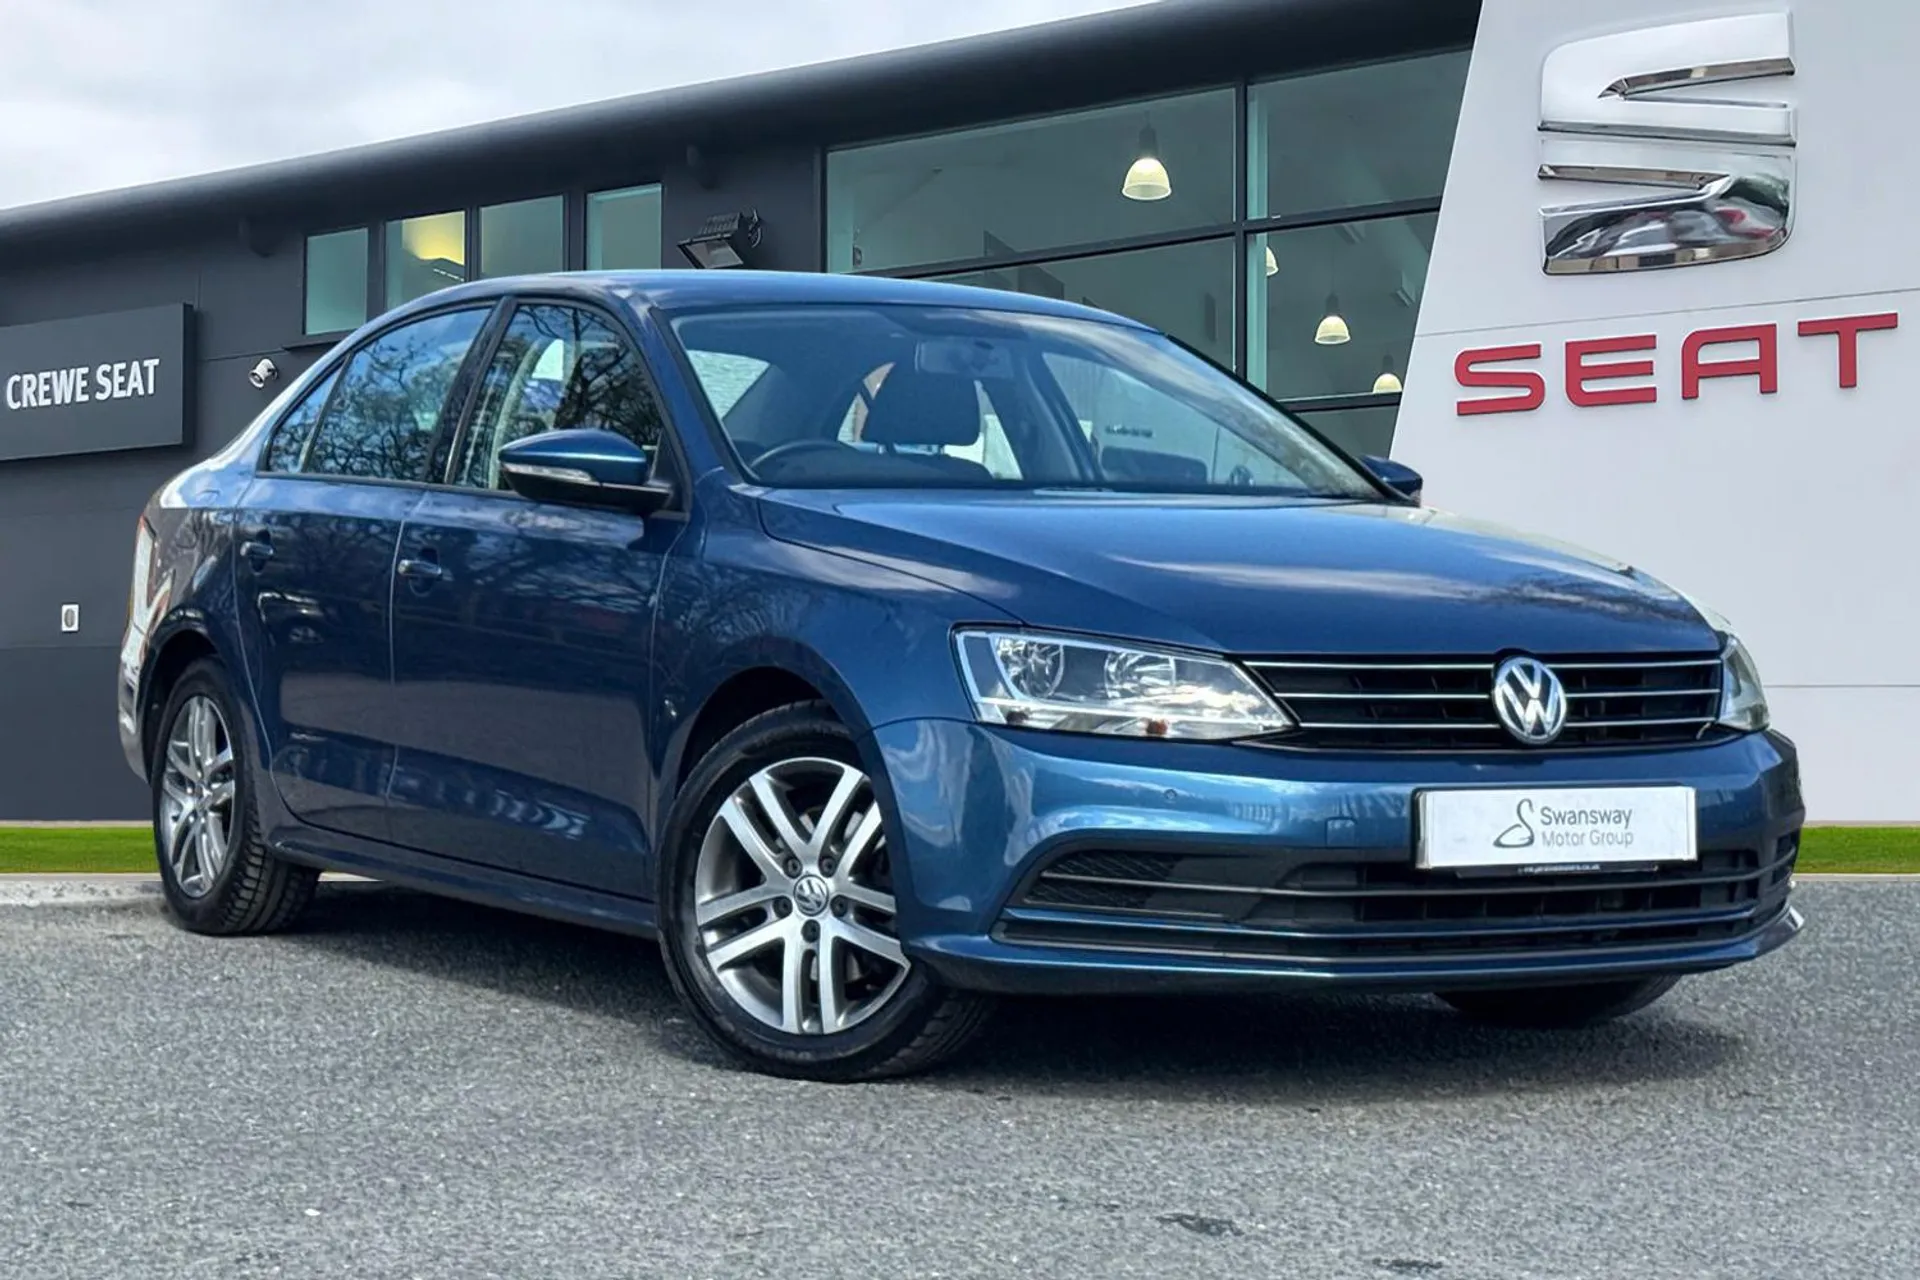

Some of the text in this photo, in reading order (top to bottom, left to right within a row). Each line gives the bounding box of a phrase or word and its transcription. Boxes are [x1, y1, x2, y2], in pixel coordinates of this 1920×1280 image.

[1454, 312, 1898, 416] SEAT
[6, 358, 160, 409] CREWE SEAT
[1540, 805, 1633, 829] Swansway
[1541, 829, 1634, 847] Motor Group
